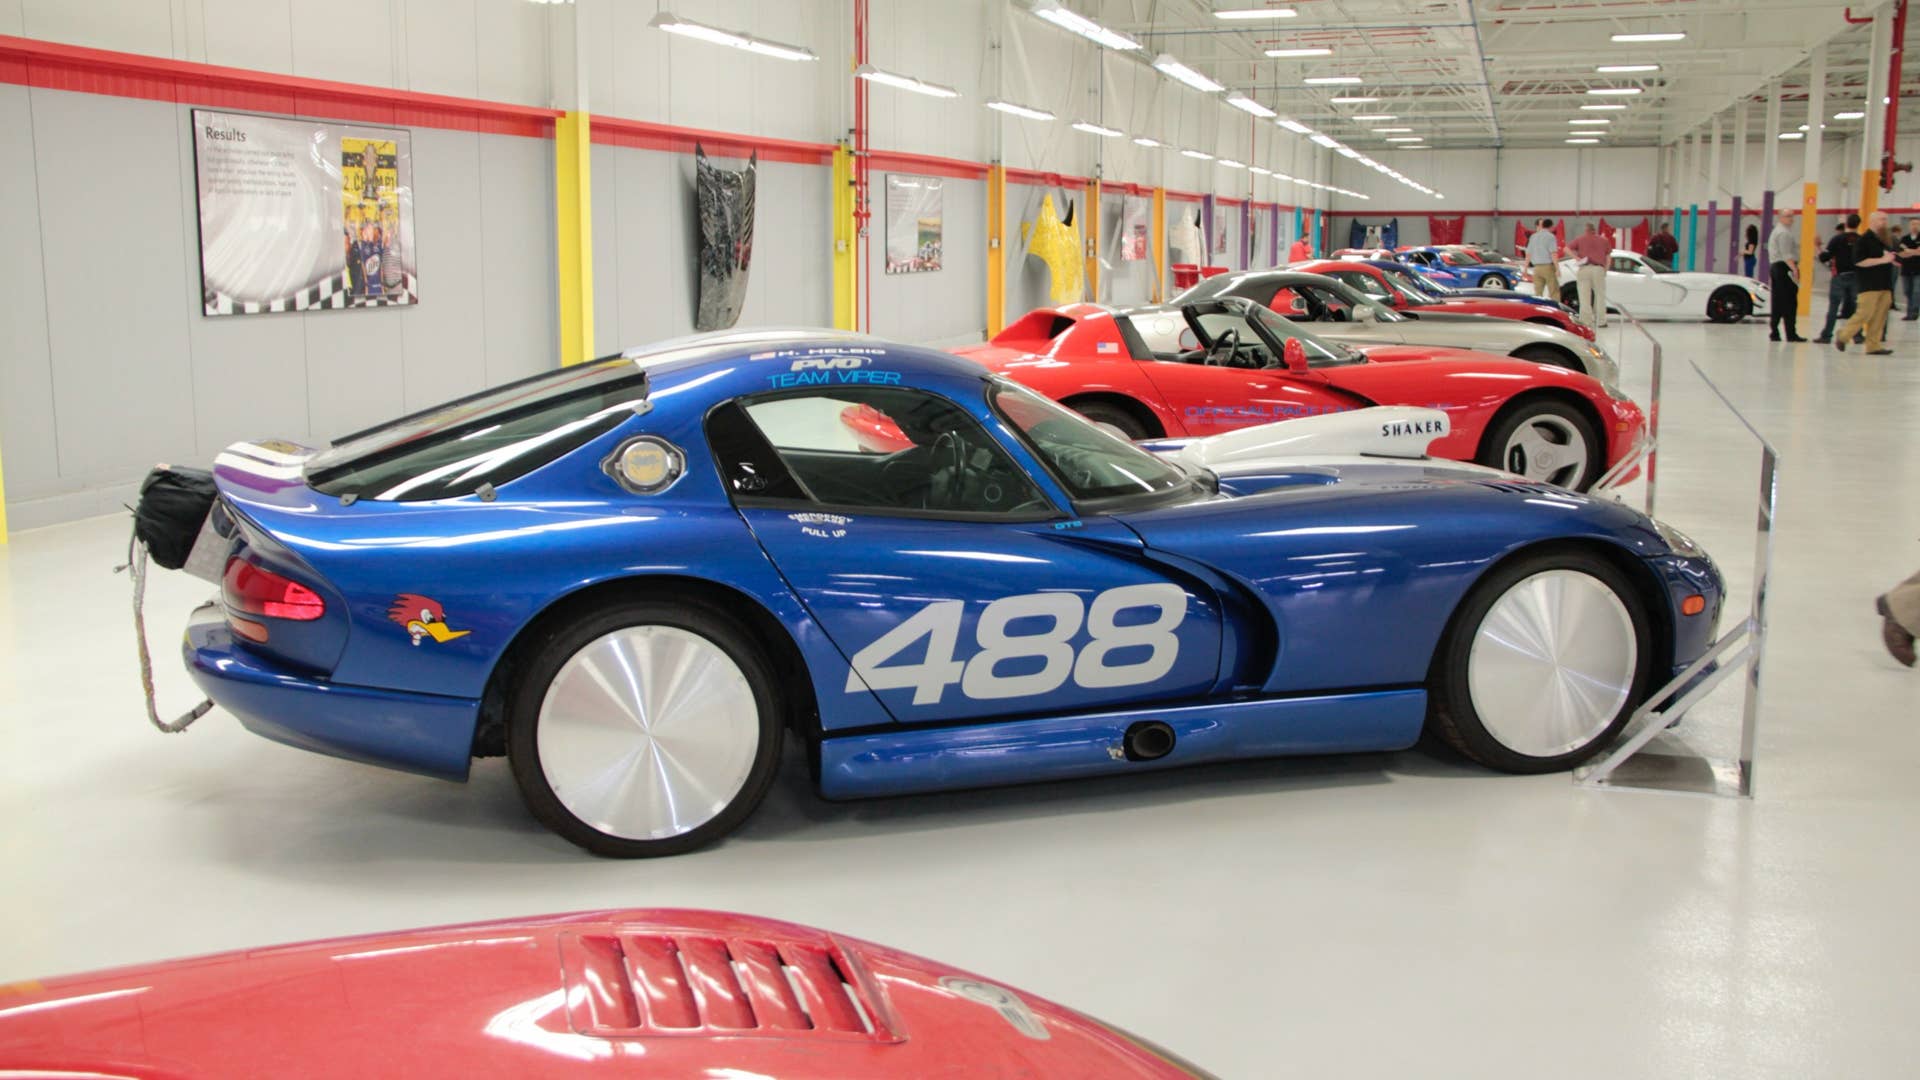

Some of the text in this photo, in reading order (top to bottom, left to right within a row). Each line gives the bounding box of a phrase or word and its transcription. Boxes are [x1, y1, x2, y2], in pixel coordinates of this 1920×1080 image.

[205, 126, 247, 142] Results
[790, 357, 862, 371] PVO
[767, 370, 902, 388] TEAM VIPER
[1185, 405, 1270, 418] OFFICIAL
[1273, 405, 1316, 417] PACE
[1382, 420, 1443, 437] SHAKER
[801, 526, 847, 538] PULL UP
[844, 583, 1188, 706] 488
